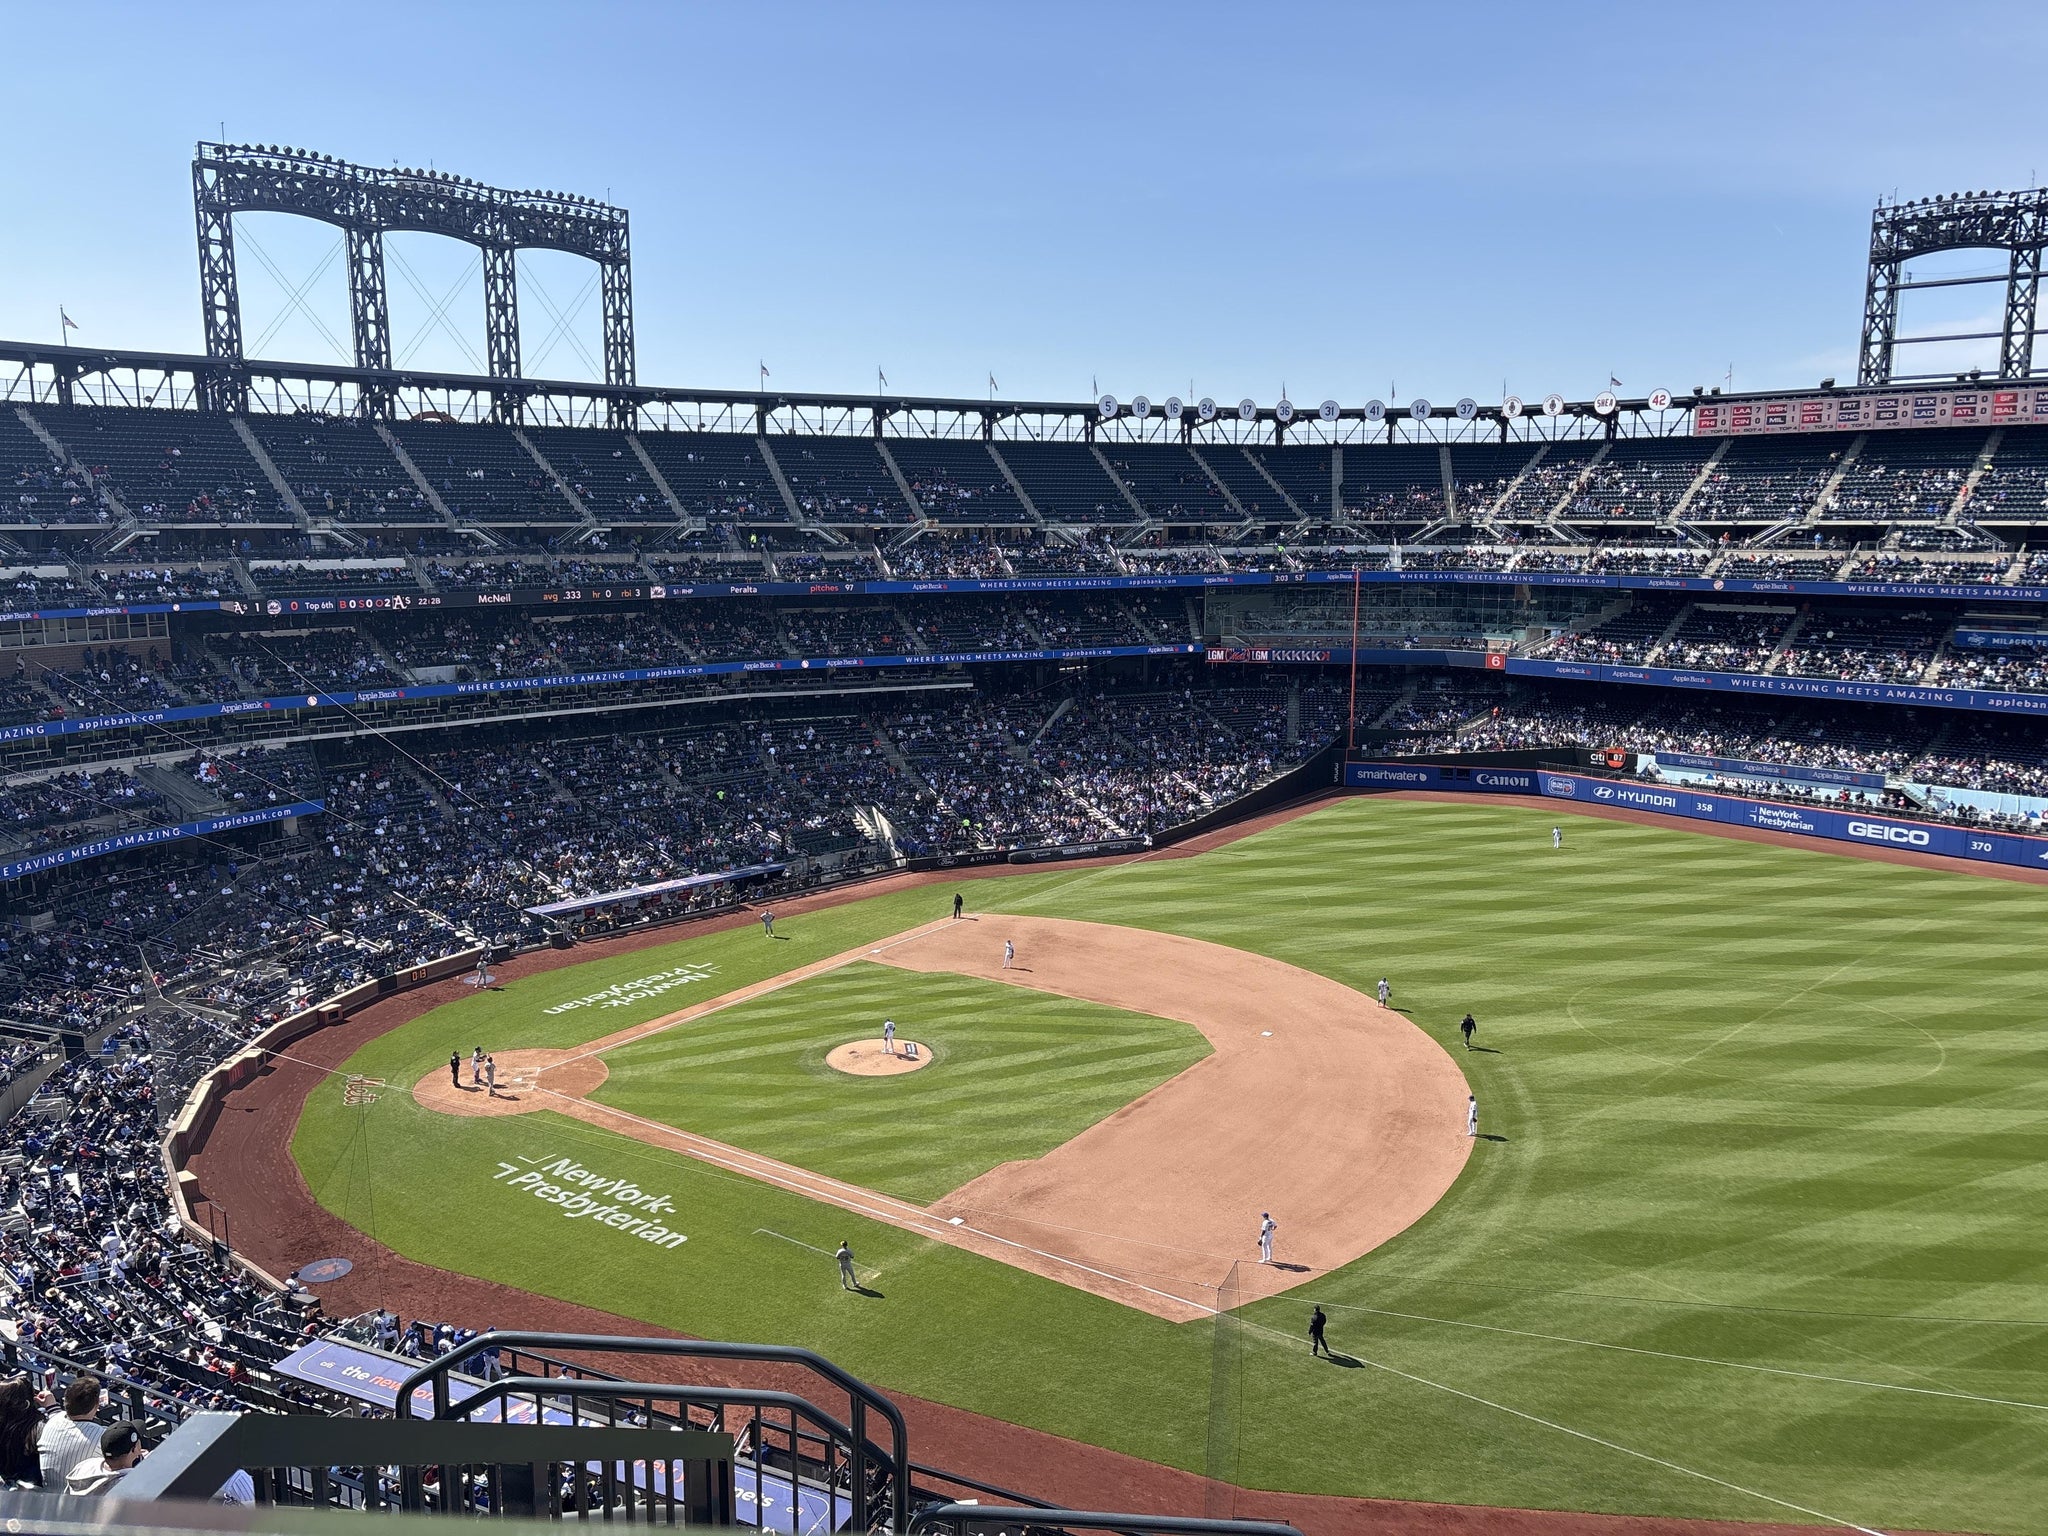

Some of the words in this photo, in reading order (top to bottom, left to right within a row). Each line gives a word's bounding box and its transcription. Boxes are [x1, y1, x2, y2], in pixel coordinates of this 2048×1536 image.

[1596, 398, 1613, 408] SHEA
[1652, 395, 1666, 406] 42
[1105, 401, 1112, 412] 5
[1137, 402, 1146, 412] 18
[1170, 403, 1178, 413] 16
[1202, 404, 1212, 414] 24
[1243, 405, 1252, 415] 17
[1280, 406, 1290, 416] 36
[1325, 406, 1334, 416] 31
[1370, 406, 1380, 416] 41
[1416, 405, 1425, 415] 14
[1460, 404, 1472, 414] 37
[1128, 578, 1177, 586] applebank.com
[1552, 576, 1606, 584] applebank.com
[730, 586, 758, 594] Peralta
[810, 585, 838, 594] pitches
[845, 584, 854, 592] 97
[1752, 582, 1770, 590] Apple
[478, 593, 511, 603] McNeil
[543, 593, 558, 602] avg
[563, 590, 581, 600] .333
[592, 590, 601, 598] hr
[605, 589, 612, 598] 0
[621, 589, 632, 598] rbi
[635, 588, 641, 597] 3
[1848, 585, 1886, 593] WHERE
[1892, 586, 1935, 594] SAVING
[1940, 588, 1978, 596] MEETS
[1984, 589, 2042, 598] AMAZING
[254, 602, 260, 612] 1
[290, 602, 298, 610] 0
[304, 602, 320, 612] Top
[320, 600, 334, 610] 6th
[340, 600, 347, 609] B
[348, 600, 356, 608] 0
[358, 600, 365, 608] S
[366, 599, 373, 608] 0
[384, 598, 391, 608] 2
[86, 608, 104, 616] Apple
[105, 606, 122, 614] Bank
[1992, 638, 2034, 646] MILAGRO
[975, 653, 1002, 661] MEETS
[1006, 652, 1044, 660] AMAZING
[1062, 649, 1112, 657] applebank.com
[1208, 650, 1224, 660] LGM
[1252, 650, 1268, 660] LGM
[1492, 656, 1500, 666] 6
[457, 682, 495, 692] WHERE
[500, 680, 538, 690] SAVING
[544, 676, 576, 686] MEETS
[580, 673, 626, 684] AMAZING
[646, 667, 703, 678] applebank.com
[1672, 675, 1688, 683] Apple
[1690, 676, 1706, 684] Bank
[1731, 678, 1774, 689] WHERE
[1780, 682, 1830, 693] SAVING
[1836, 686, 1880, 696] MEETS
[1886, 690, 1954, 702] AMAZING
[354, 692, 376, 702] Apple
[377, 690, 398, 699] Bank
[220, 704, 242, 714] Apple
[243, 702, 262, 710] Bank
[78, 713, 164, 730] applebank.com
[1590, 752, 1604, 762] citi
[1613, 754, 1622, 762] 07
[1743, 764, 1762, 774] Apple
[1762, 766, 1780, 774] Bank
[1357, 770, 1418, 782] smartwater
[1476, 774, 1529, 787] Canon
[1812, 770, 1831, 780] Apple
[1832, 772, 1852, 782] Bank
[1618, 790, 1676, 808] HYUNDAI
[1696, 802, 1712, 812] 358
[1758, 806, 1802, 820] NewYork-
[1758, 816, 1814, 831] Presbyterian
[1848, 822, 1930, 846] GEICO
[16, 852, 65, 872] SAVING
[71, 841, 110, 859] MEETS
[116, 828, 180, 848] AMAZING
[212, 808, 292, 830] applebank.com
[1970, 842, 1992, 852] 370
[542, 967, 690, 1014] Presbyterian
[600, 972, 712, 1009] NewYork-
[541, 1158, 676, 1214] NewYork-
[506, 1172, 688, 1248] Presbyterian
[341, 1365, 370, 1380] the
